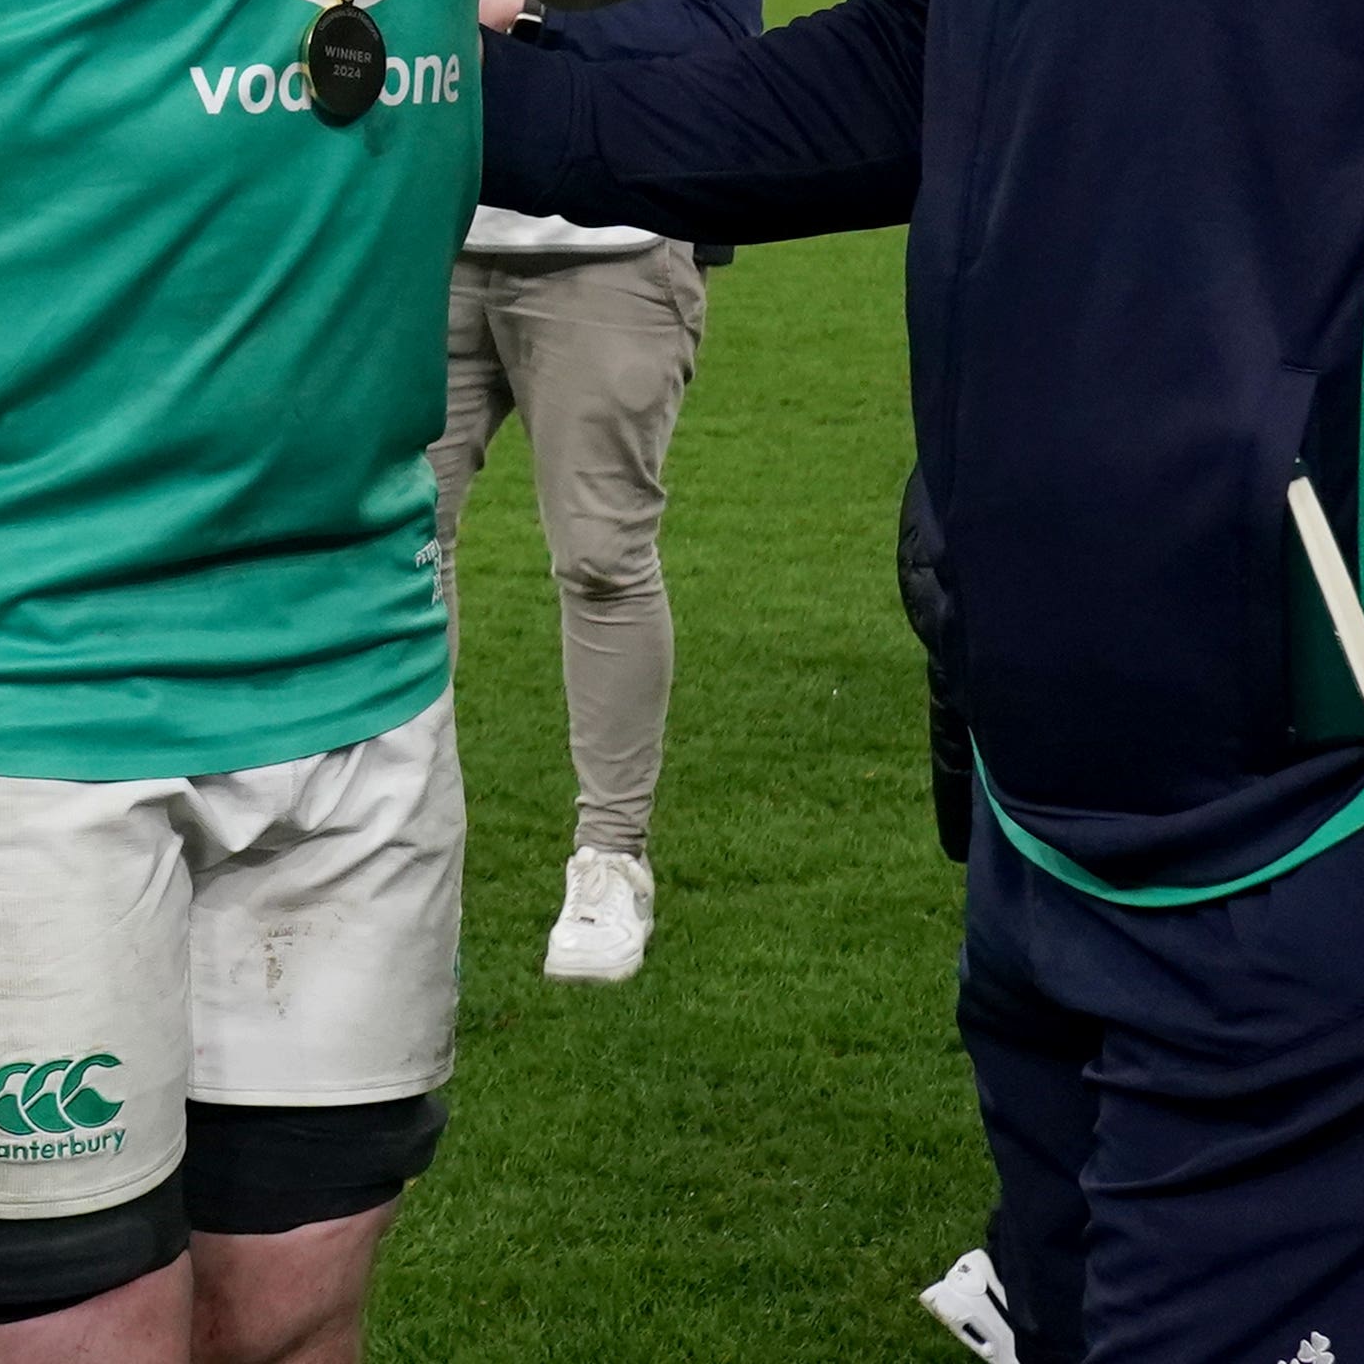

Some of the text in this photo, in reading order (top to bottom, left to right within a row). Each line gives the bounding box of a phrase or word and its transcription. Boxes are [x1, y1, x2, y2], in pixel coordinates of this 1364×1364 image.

[324, 44, 373, 64] WINNER
[333, 64, 362, 79] 2024
[189, 52, 460, 115] vodone
